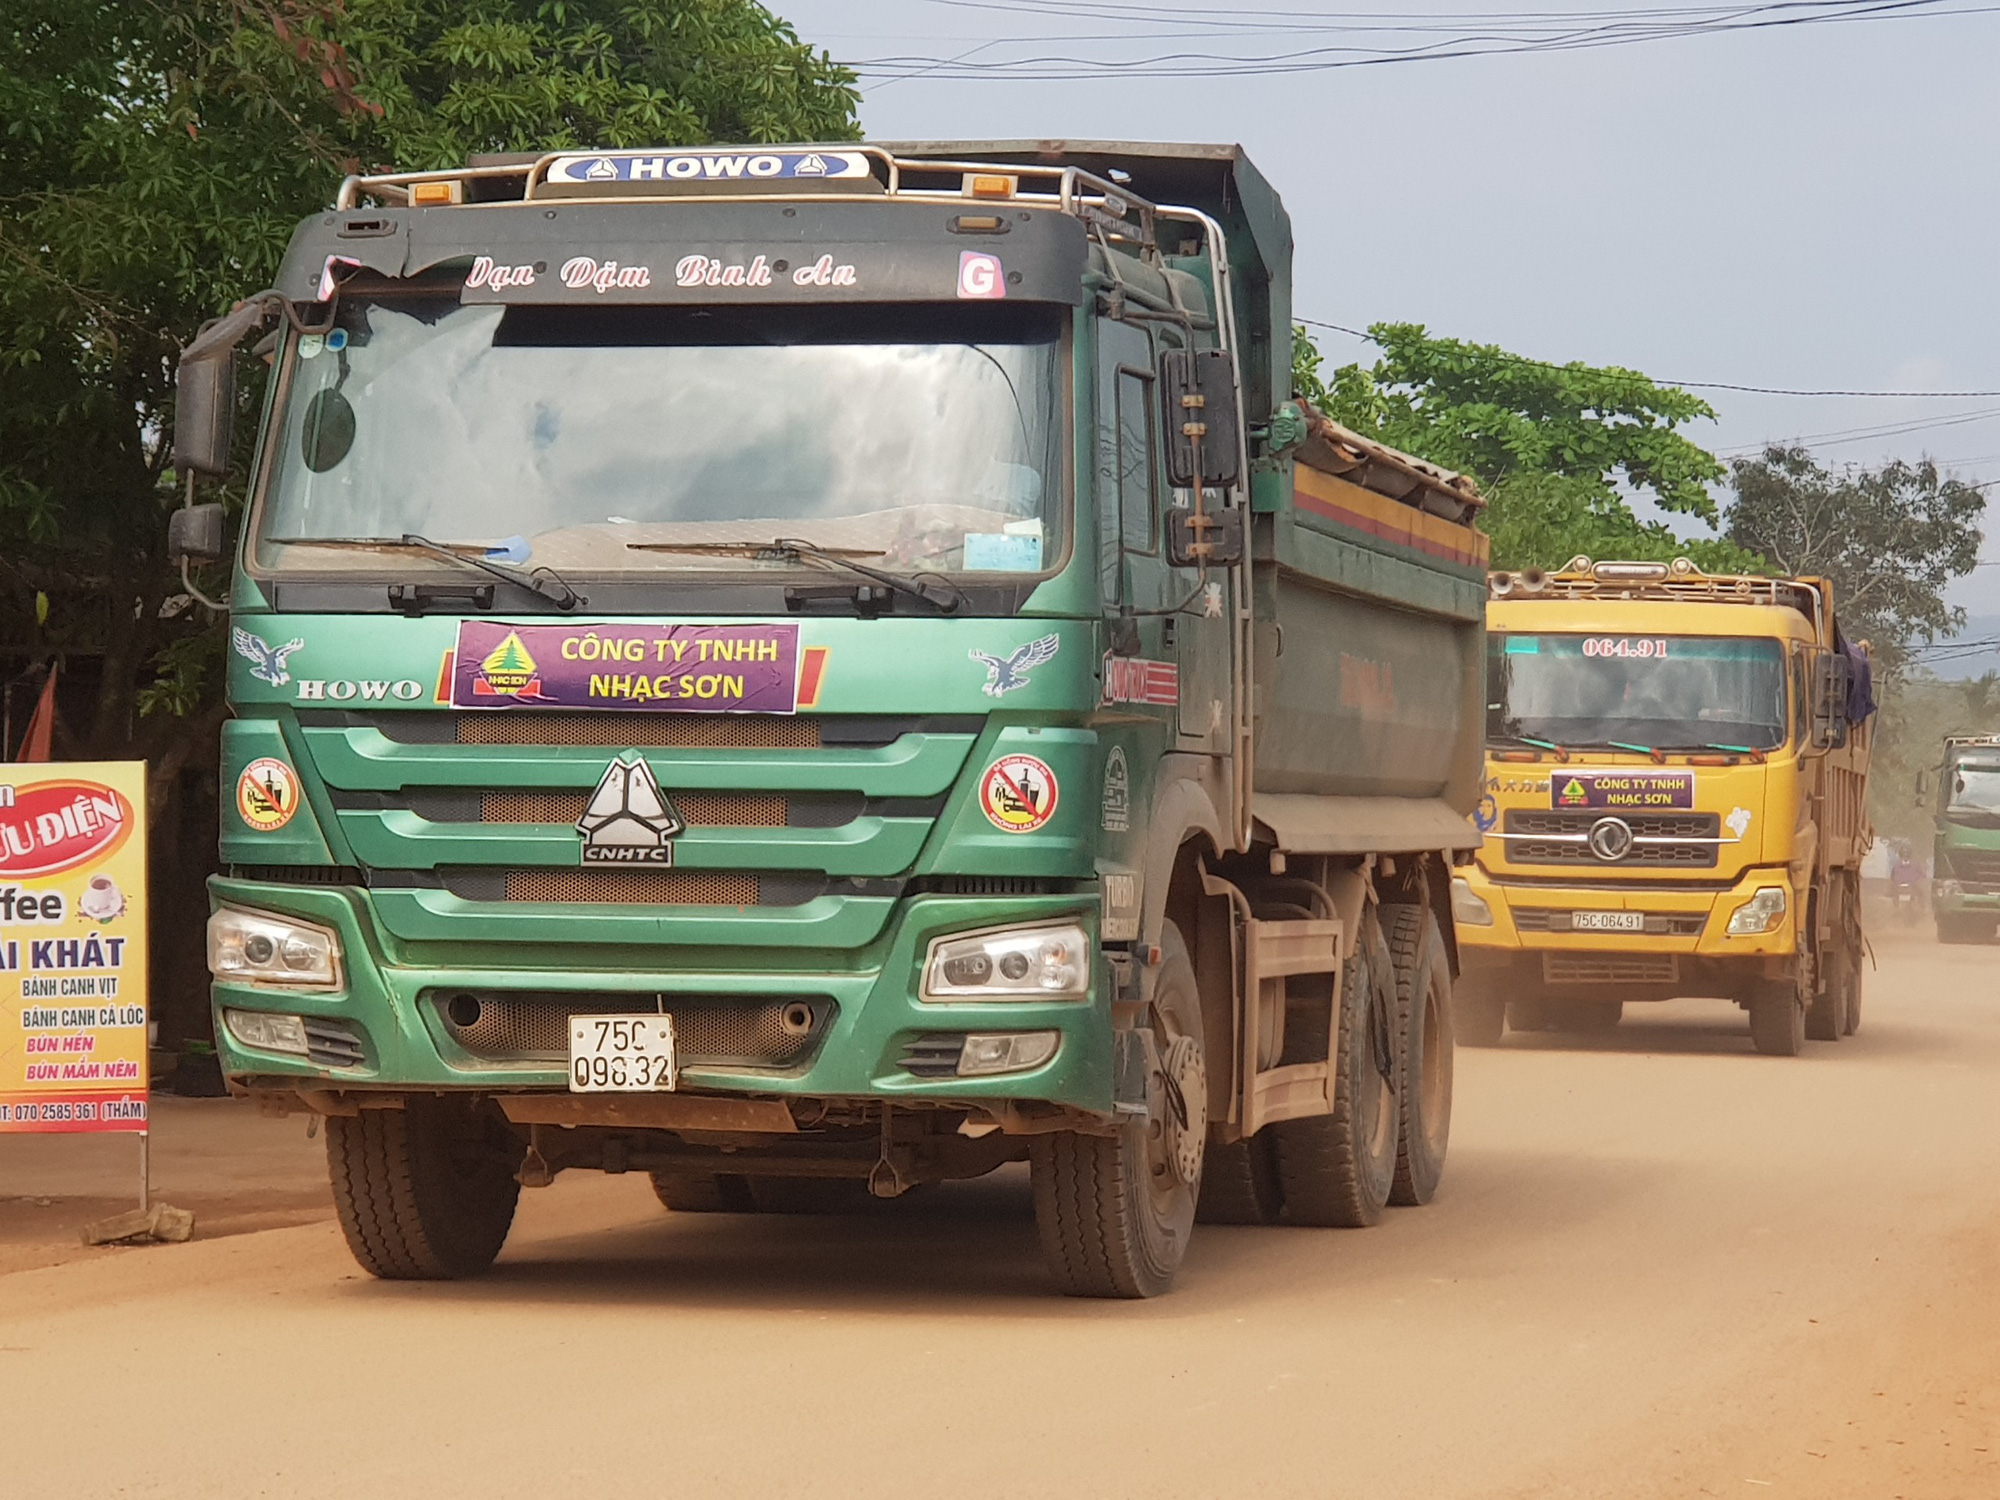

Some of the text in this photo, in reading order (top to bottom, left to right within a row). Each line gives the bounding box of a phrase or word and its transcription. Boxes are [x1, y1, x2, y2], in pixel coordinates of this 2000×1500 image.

[630, 156, 783, 178] HOWO
[560, 256, 651, 293] Dặm
[676, 255, 772, 287] Bình
[793, 254, 857, 286] An
[962, 257, 995, 295] G
[561, 632, 778, 661] CÔNG TY TNHH
[1582, 638, 1667, 657] 064.91
[295, 679, 424, 701] HOWO
[589, 674, 744, 703] NHẠC SƠN
[1594, 777, 1684, 789] CÔNG TY TNHH
[1607, 793, 1672, 806] NHẠC SƠN
[36, 790, 123, 847] ĐIỆN
[586, 848, 665, 860] CNHTC
[0, 888, 62, 920] fee
[32, 932, 124, 969] KHÁT
[23, 976, 117, 998] BÁNH CANH VỊT
[23, 1004, 143, 1027] BÁNH CANH CÁ LÓC
[27, 1030, 94, 1052] BÚN HẾN
[595, 1021, 647, 1052] 75C
[27, 1062, 59, 1079] BÚN
[104, 1060, 137, 1077] NÊM
[575, 1056, 669, 1087] 098.32
[15, 1105, 37, 1120] 070
[42, 1104, 71, 1119] 2585
[76, 1104, 96, 1119] 361
